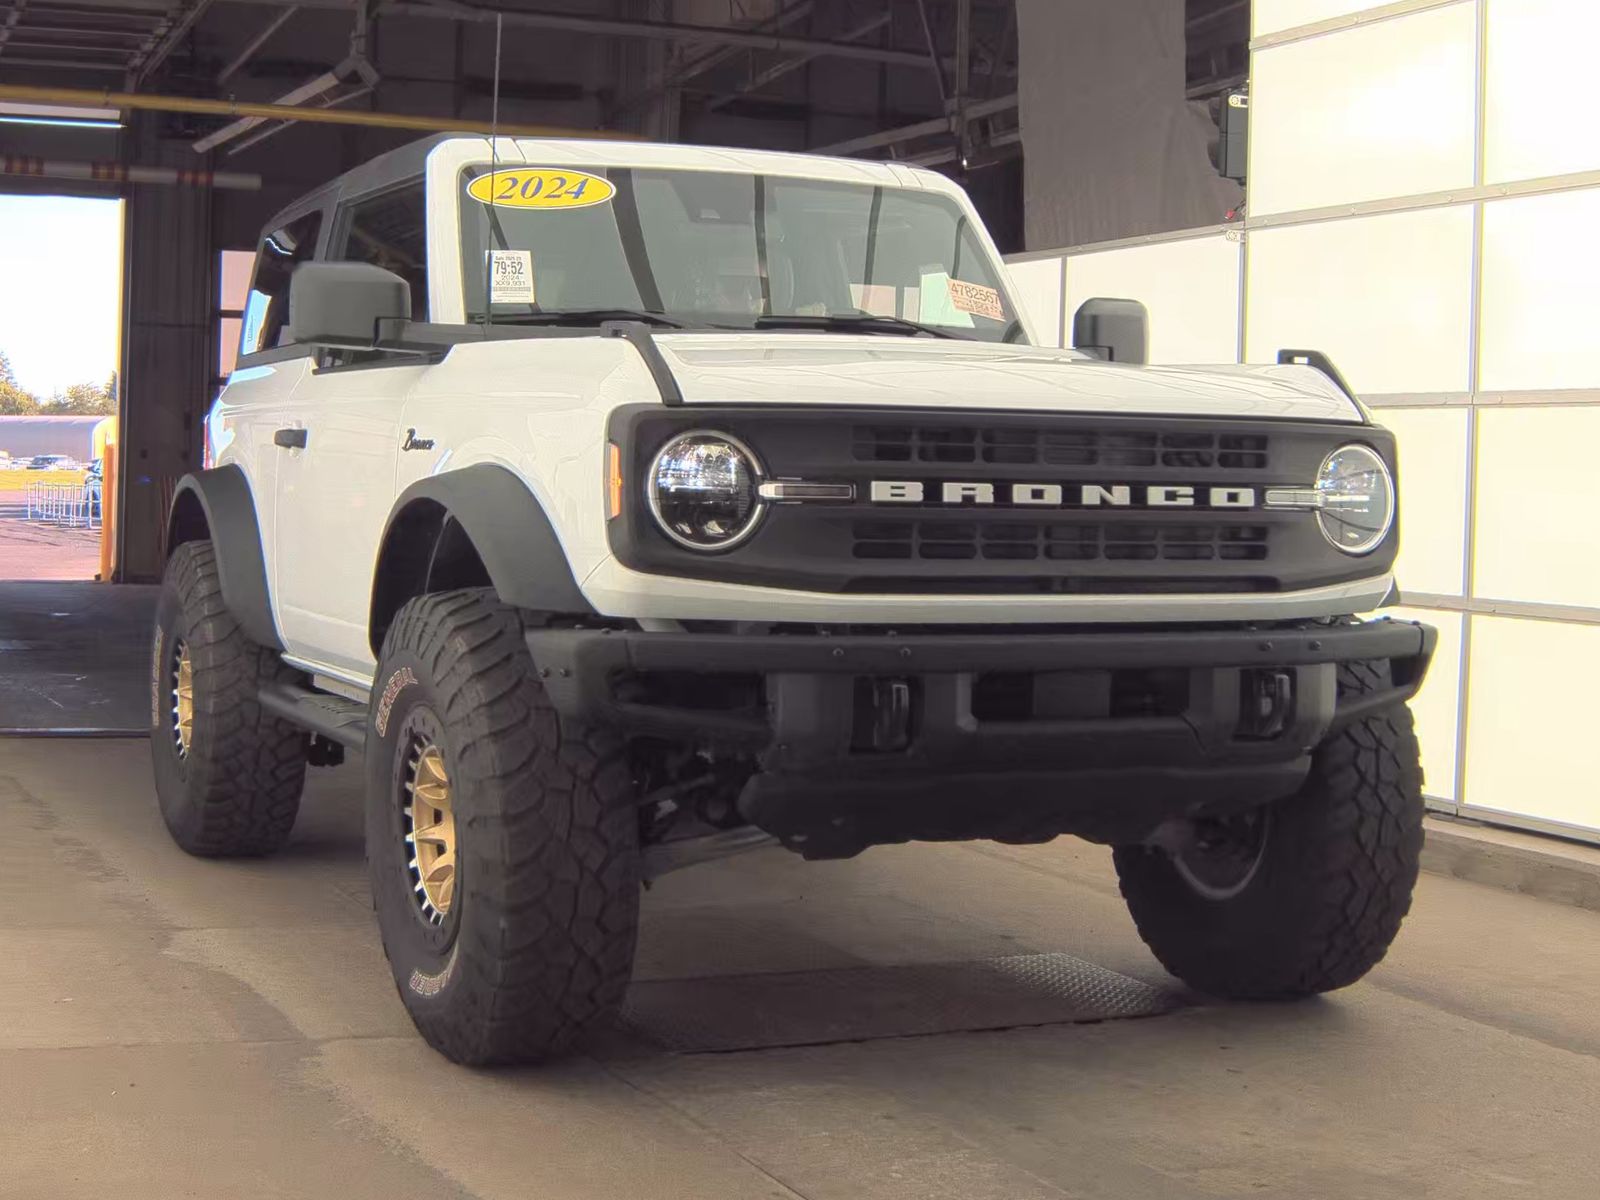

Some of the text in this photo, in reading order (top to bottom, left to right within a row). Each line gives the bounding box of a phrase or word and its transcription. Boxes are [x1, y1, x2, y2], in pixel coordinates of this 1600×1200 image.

[494, 176, 589, 200] 2024
[494, 261, 524, 275] 79:52
[871, 481, 1255, 507] BRONCO
